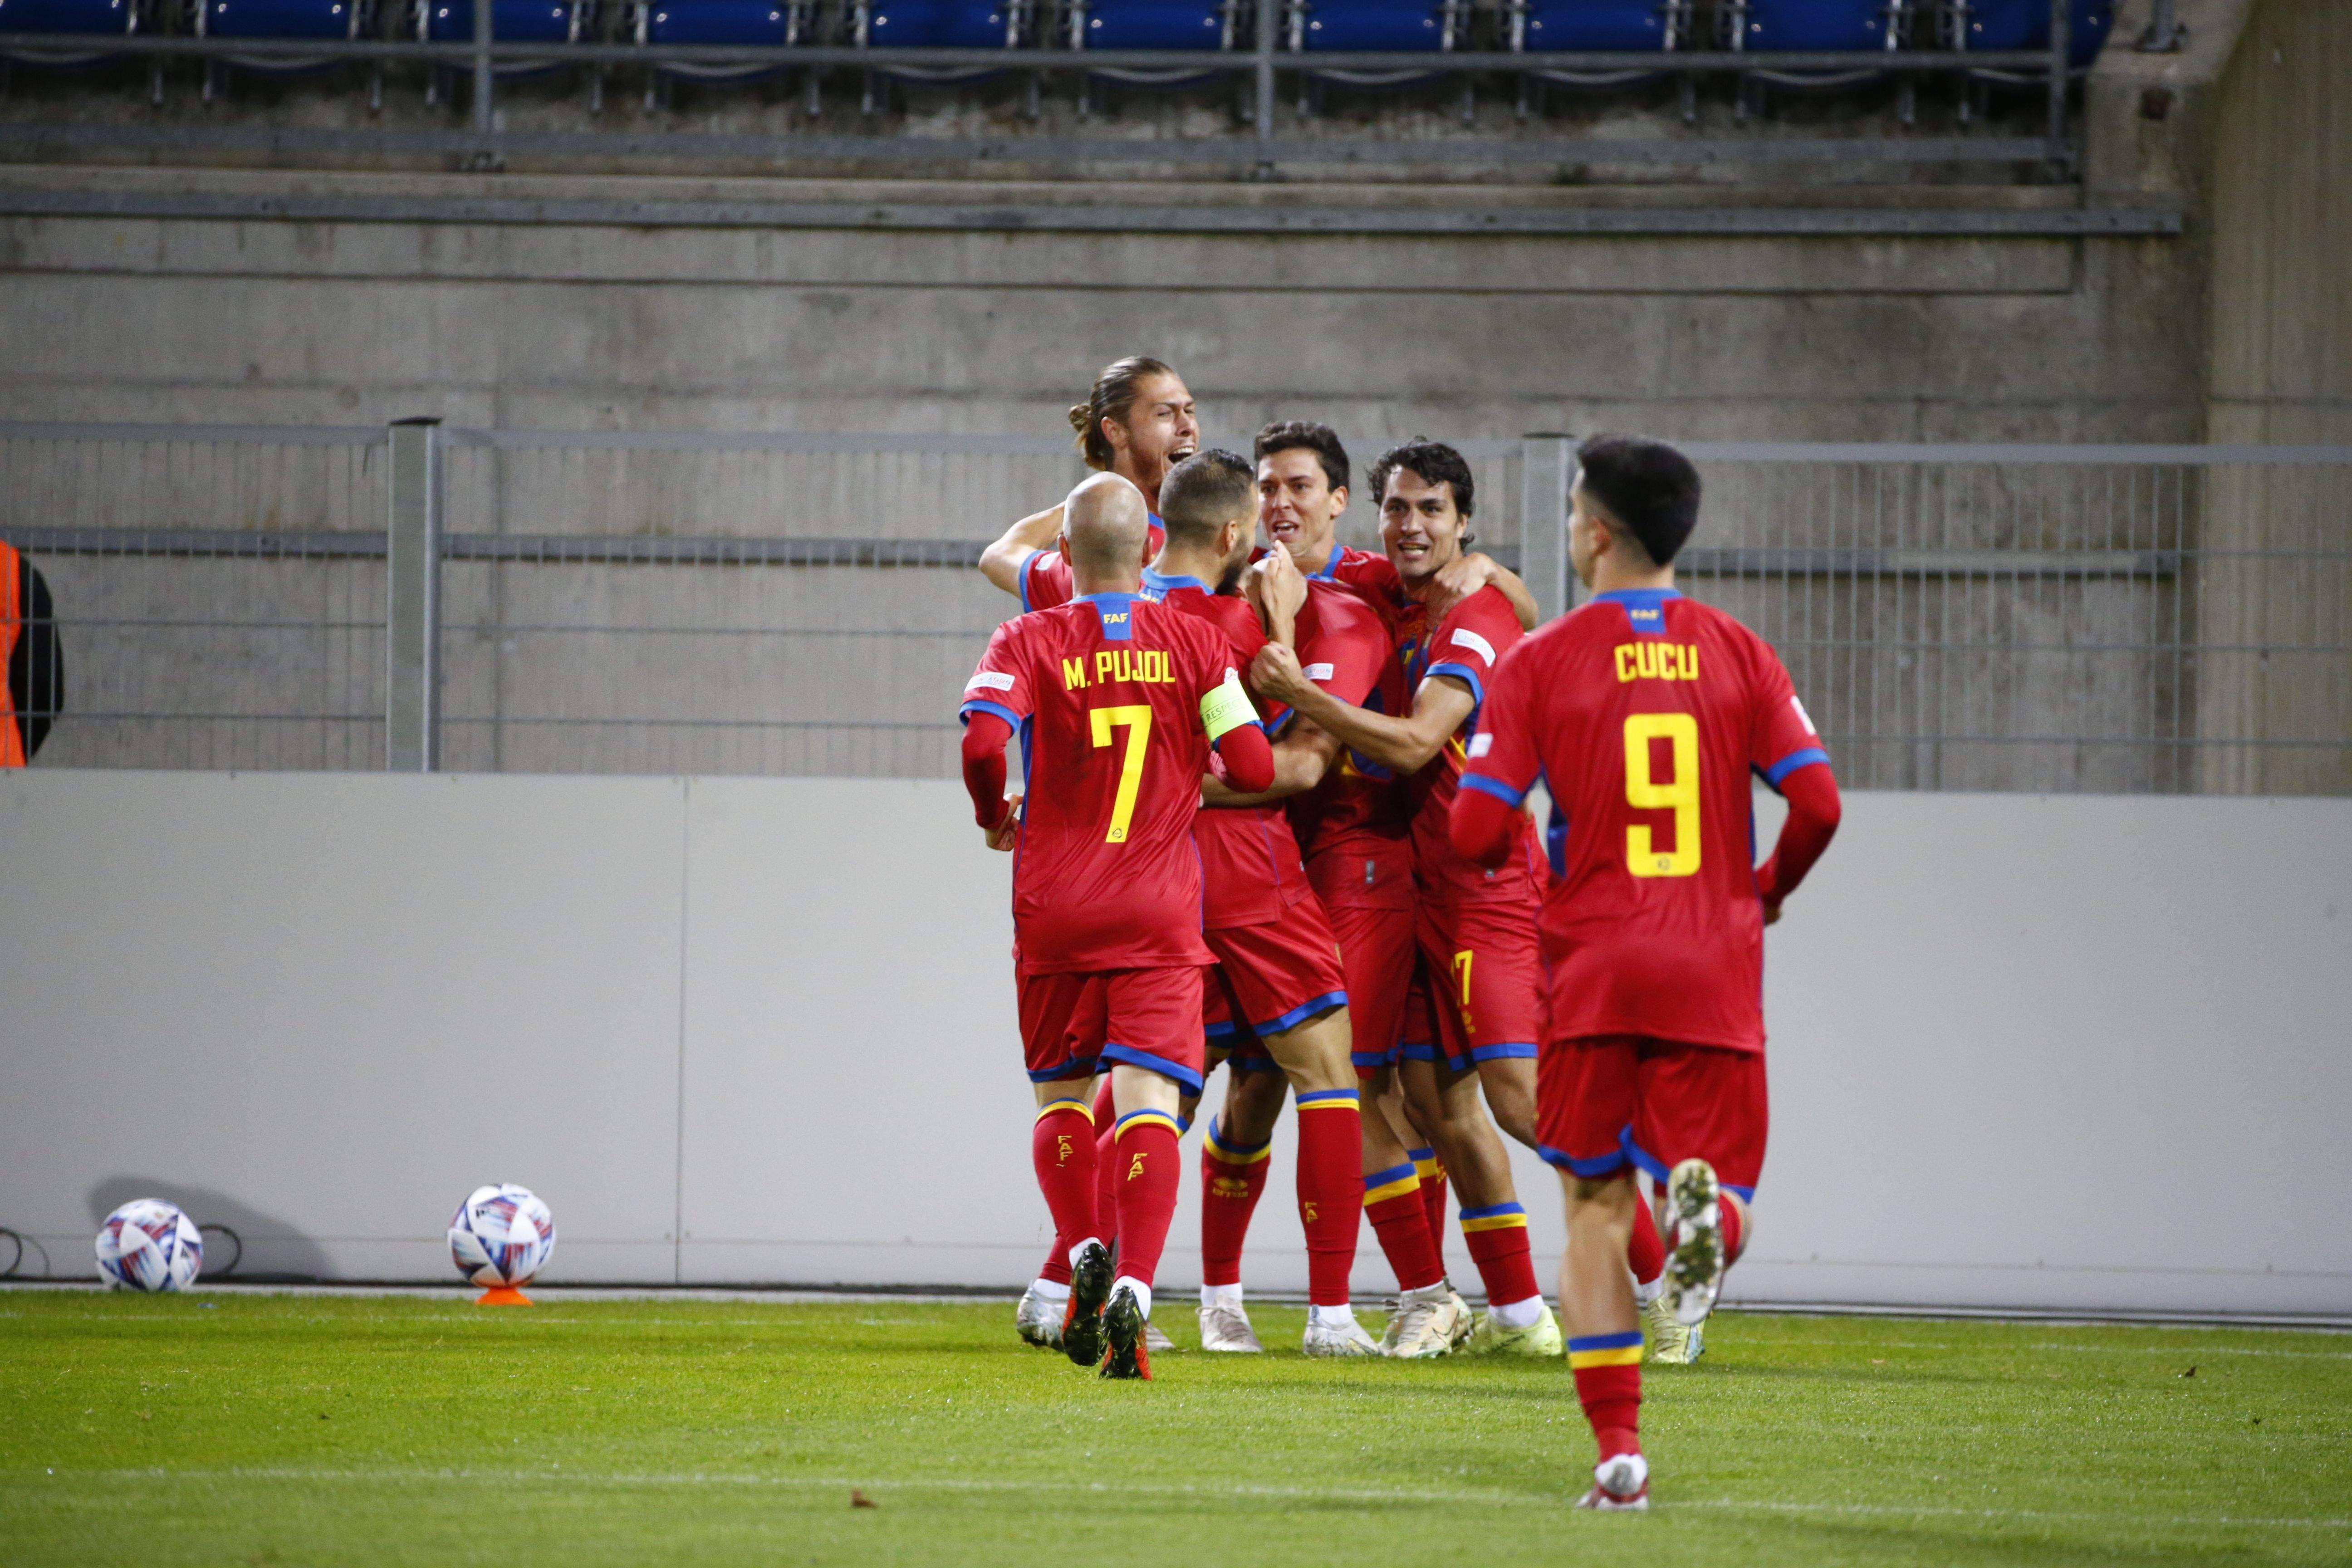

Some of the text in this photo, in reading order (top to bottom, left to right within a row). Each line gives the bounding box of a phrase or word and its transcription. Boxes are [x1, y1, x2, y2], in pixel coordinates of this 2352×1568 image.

[1103, 612, 1128, 624] FAF
[1063, 649, 1176, 691] M. PUJOL
[1614, 642, 1699, 682] CUCU
[1090, 705, 1152, 843] 7
[1623, 713, 1701, 878] 9
[1451, 950, 1473, 1008] 7
[1058, 1135, 1073, 1161] FAF
[1127, 1152, 1148, 1181] FAF
